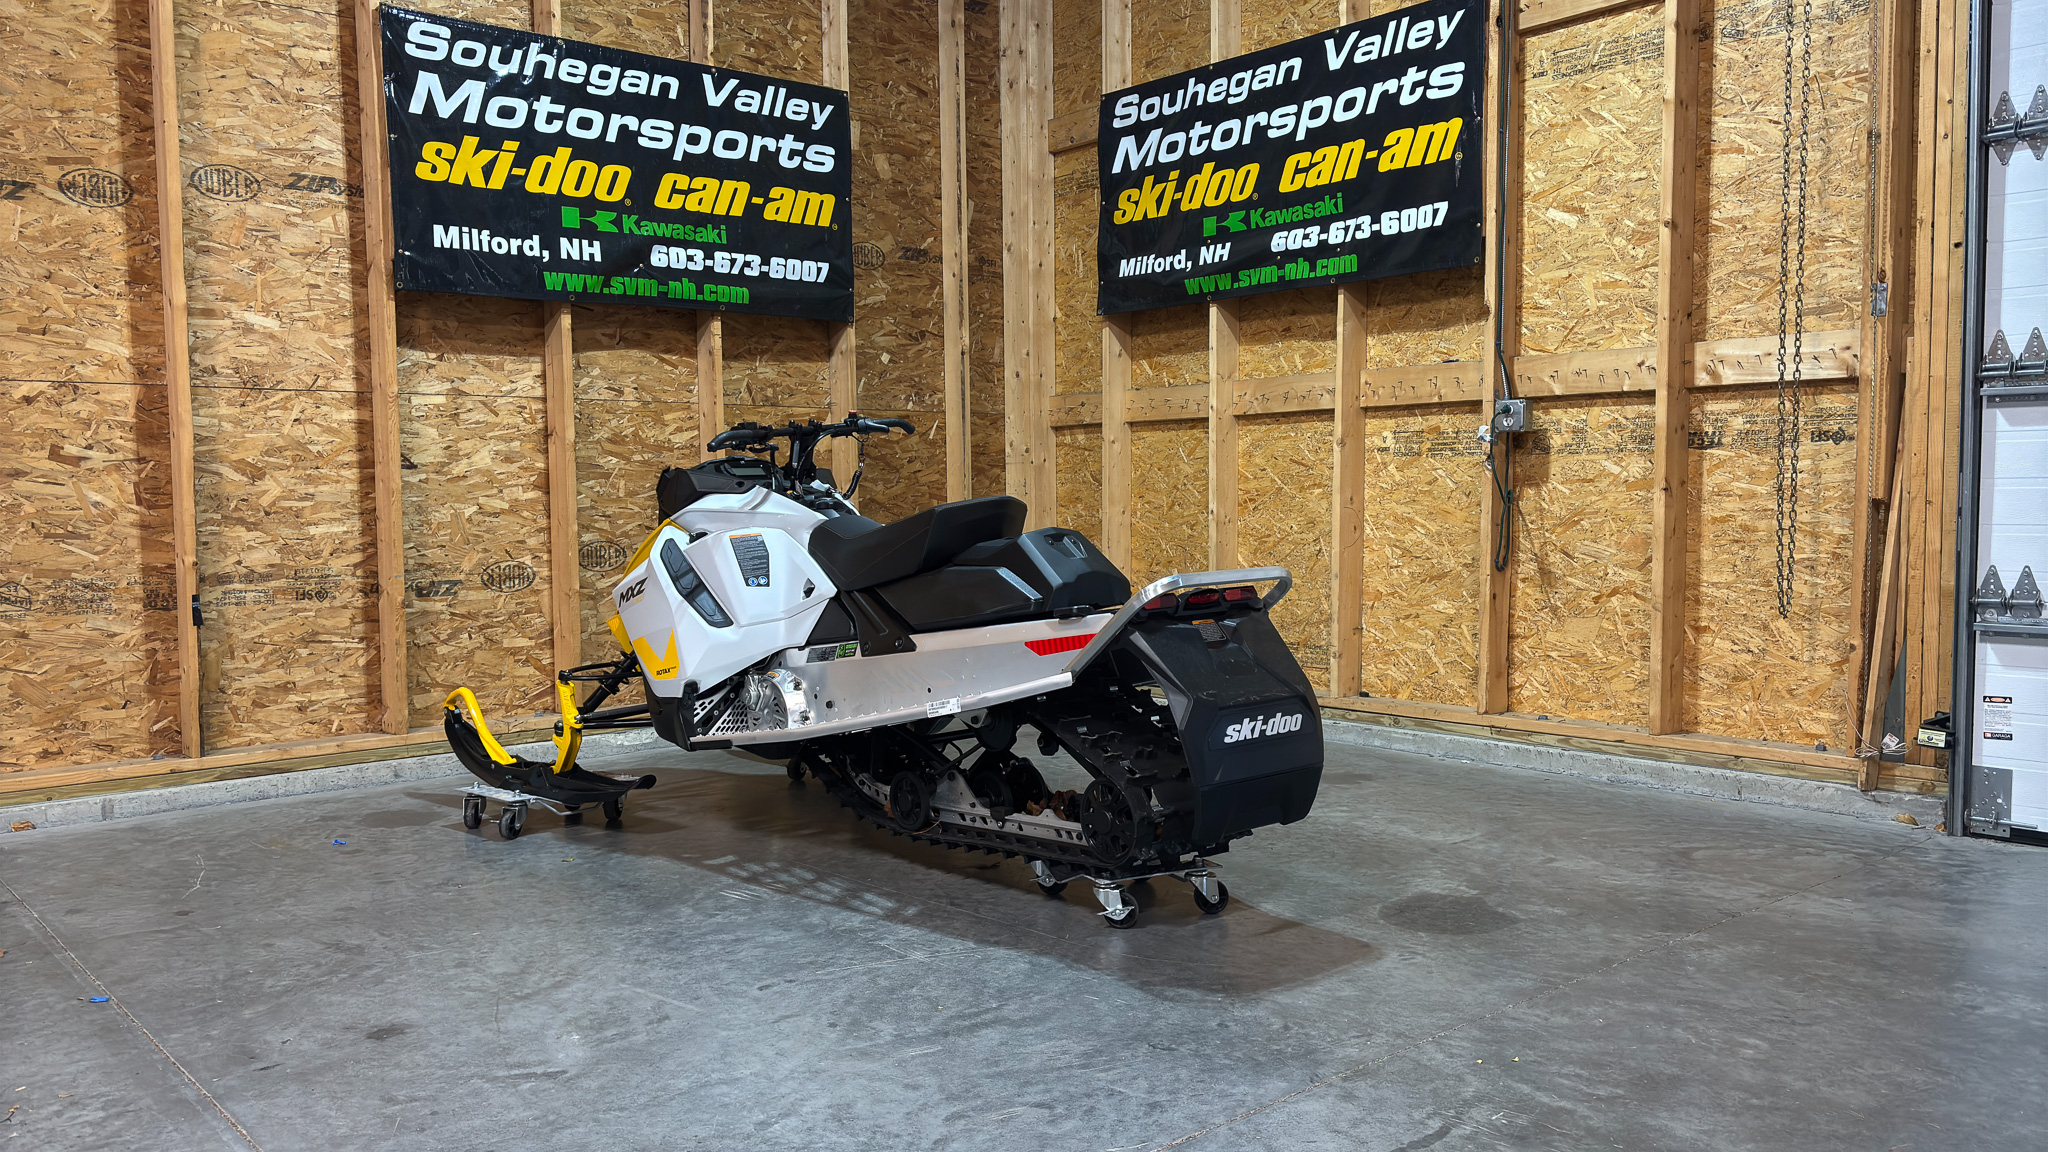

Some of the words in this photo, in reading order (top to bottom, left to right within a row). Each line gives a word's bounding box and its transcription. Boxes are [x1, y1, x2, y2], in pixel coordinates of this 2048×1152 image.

[405, 19, 680, 100] Souhegan
[702, 74, 835, 131] Valley
[1113, 57, 1302, 128] Souhegan
[1325, 9, 1466, 71] Valley
[408, 70, 836, 173] Motorsports
[1111, 62, 1466, 174] Motorsports
[415, 136, 632, 202] ski-doo
[654, 173, 836, 228] can-am
[1113, 163, 1260, 225] ski-doo
[1279, 117, 1464, 193] can-am
[622, 214, 728, 244] Kawasaki
[1249, 193, 1344, 230] Kawasaki
[1271, 201, 1449, 253] 603-673-6007
[432, 224, 550, 263] Milford,
[559, 237, 602, 263] NH
[1118, 248, 1193, 279] Milford,
[1198, 241, 1232, 267] NH
[650, 245, 830, 284] 603-673-6007
[1184, 252, 1358, 296] www.svm-nh.com
[543, 271, 750, 305] www.svm-nh.com
[581, 544, 622, 569] HUBER
[618, 576, 649, 608] MXZ
[656, 667, 671, 676] ROTAX
[1223, 712, 1303, 744] ski-doo
